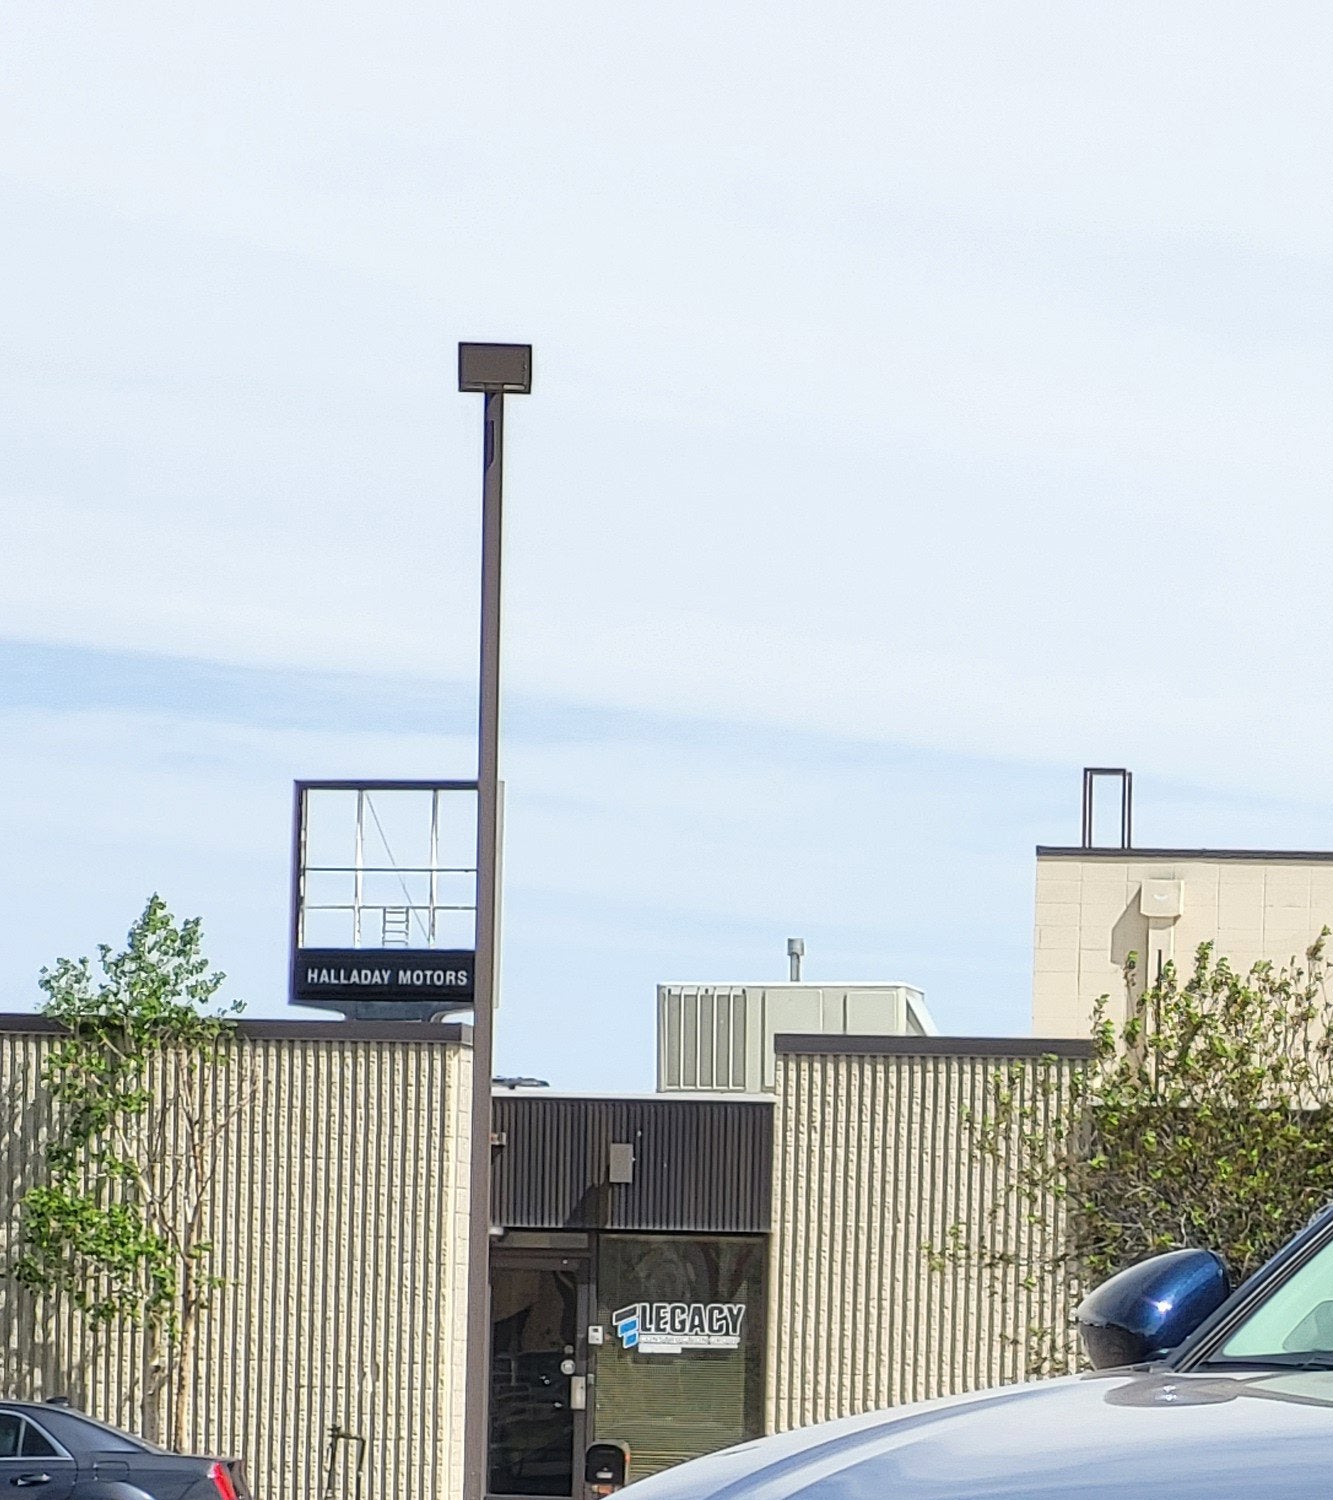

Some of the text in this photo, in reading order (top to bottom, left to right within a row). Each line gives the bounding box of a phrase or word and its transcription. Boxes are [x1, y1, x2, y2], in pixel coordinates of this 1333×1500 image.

[307, 968, 468, 986] HALLADAY MOTORS
[639, 1303, 745, 1335] LEGACY
